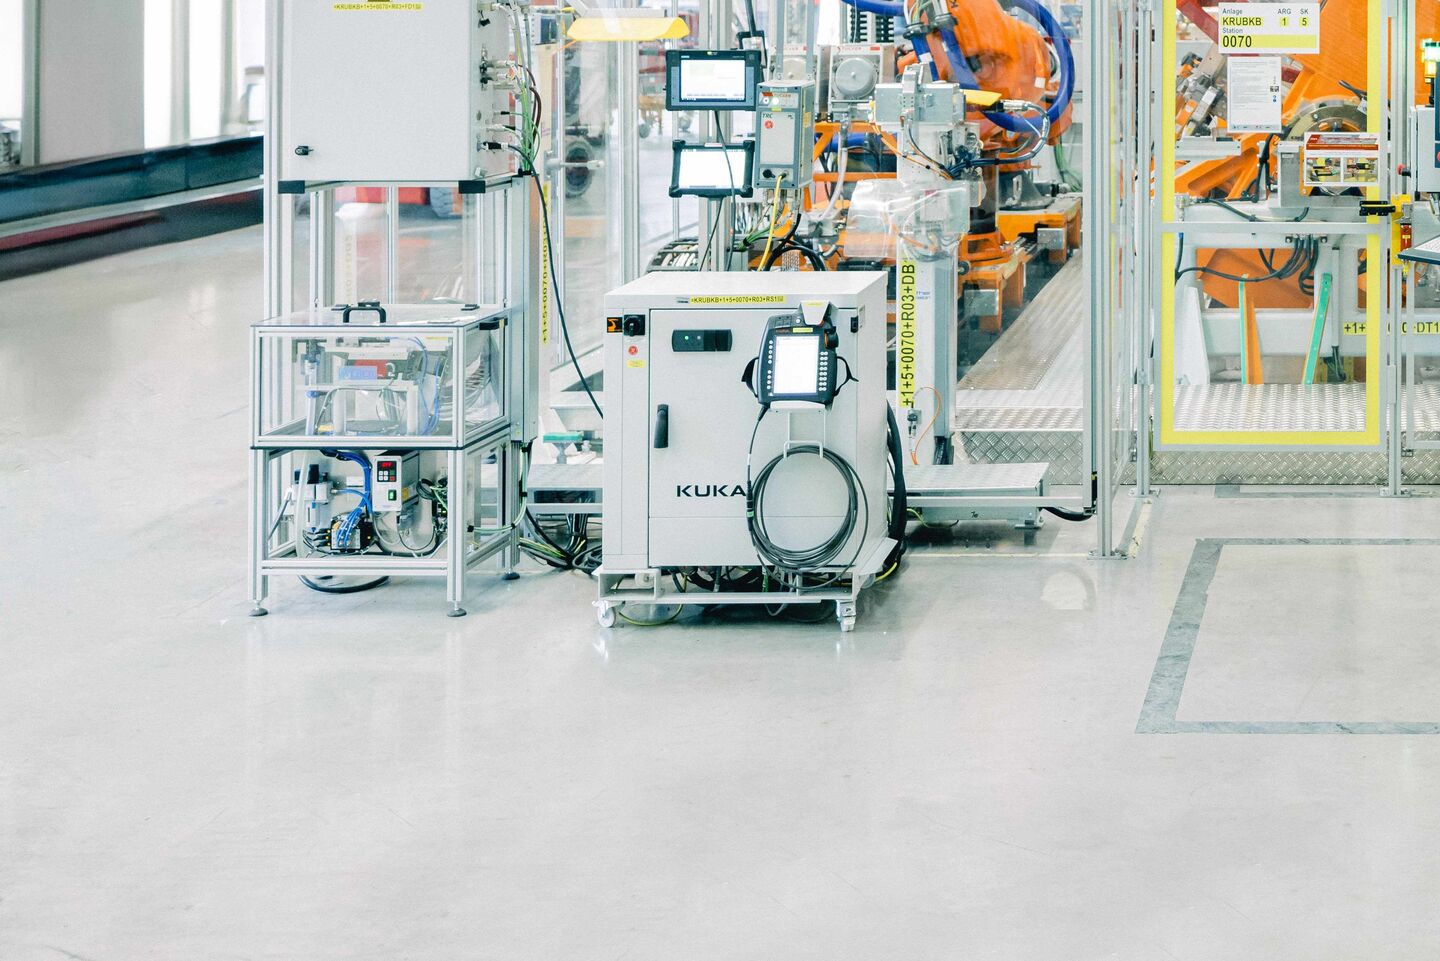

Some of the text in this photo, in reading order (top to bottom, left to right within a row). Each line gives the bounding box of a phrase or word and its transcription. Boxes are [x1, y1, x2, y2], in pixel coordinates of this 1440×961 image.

[1222, 17, 1308, 26] KRUBKB 1 5
[1222, 35, 1252, 48] 0070
[677, 485, 747, 498] KUKA
